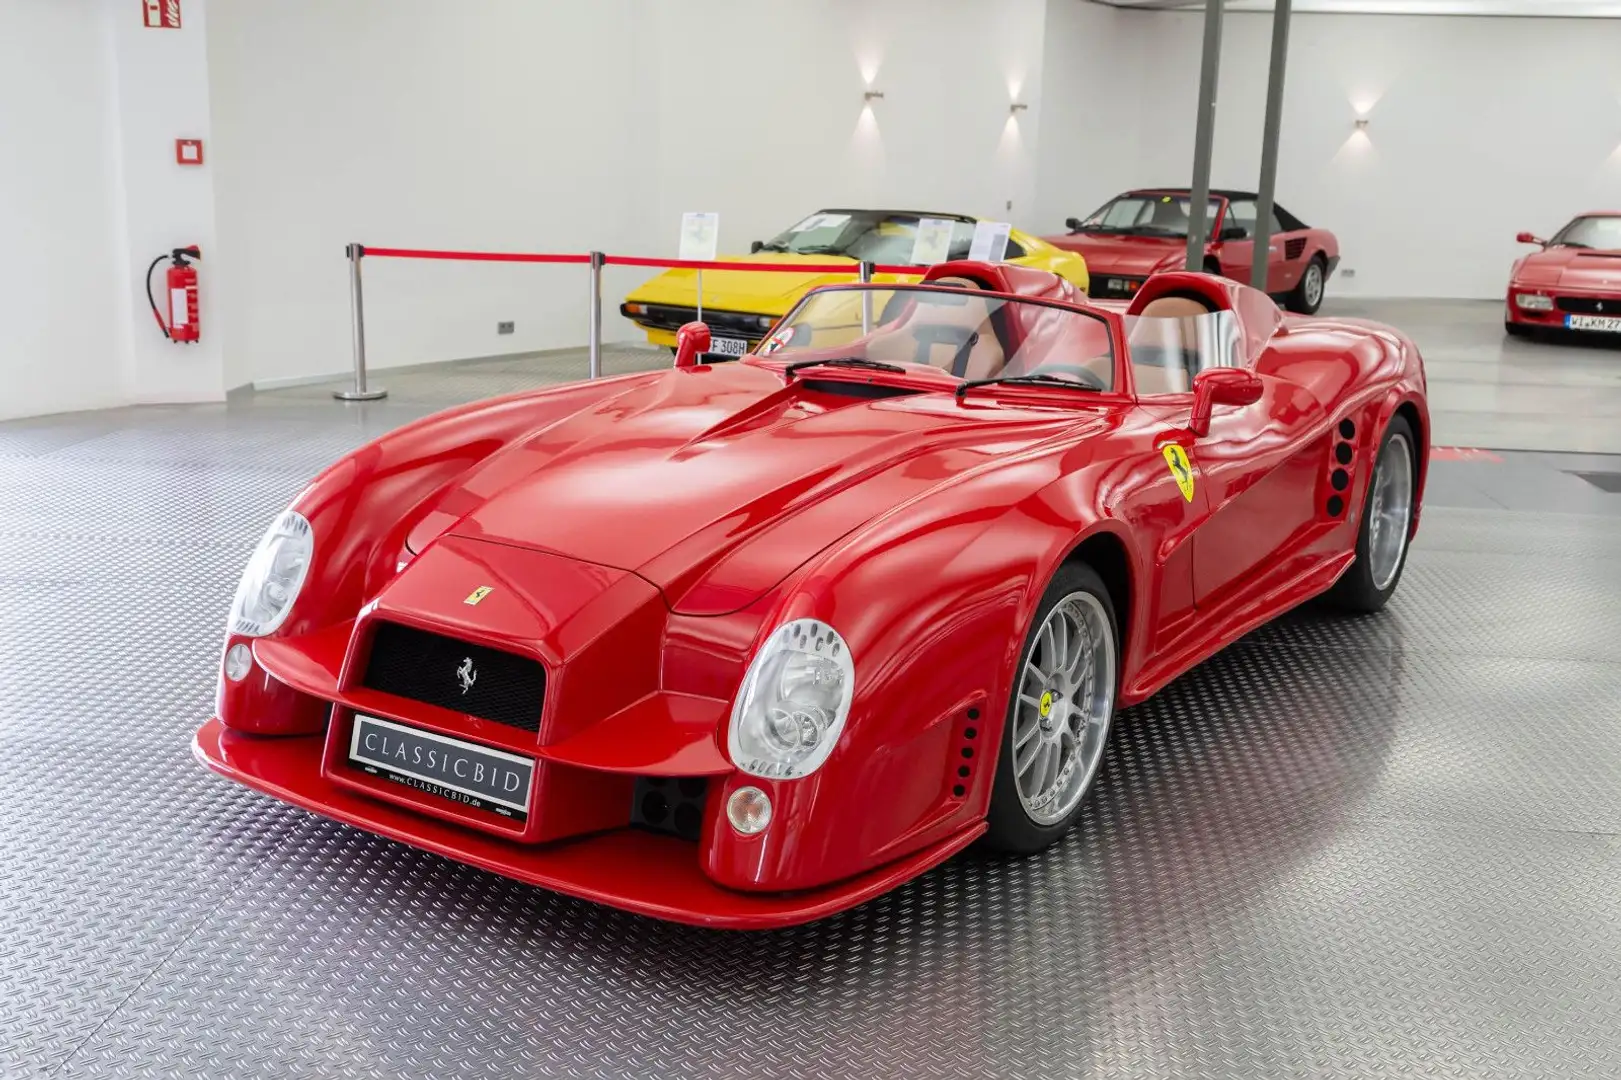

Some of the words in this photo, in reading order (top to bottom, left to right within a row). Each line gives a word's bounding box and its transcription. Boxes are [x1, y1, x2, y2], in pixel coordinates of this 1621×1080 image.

[721, 340, 745, 355] 308H
[365, 733, 520, 792] CLASSICBID
[389, 773, 481, 808] www.CLASSICBID.de
